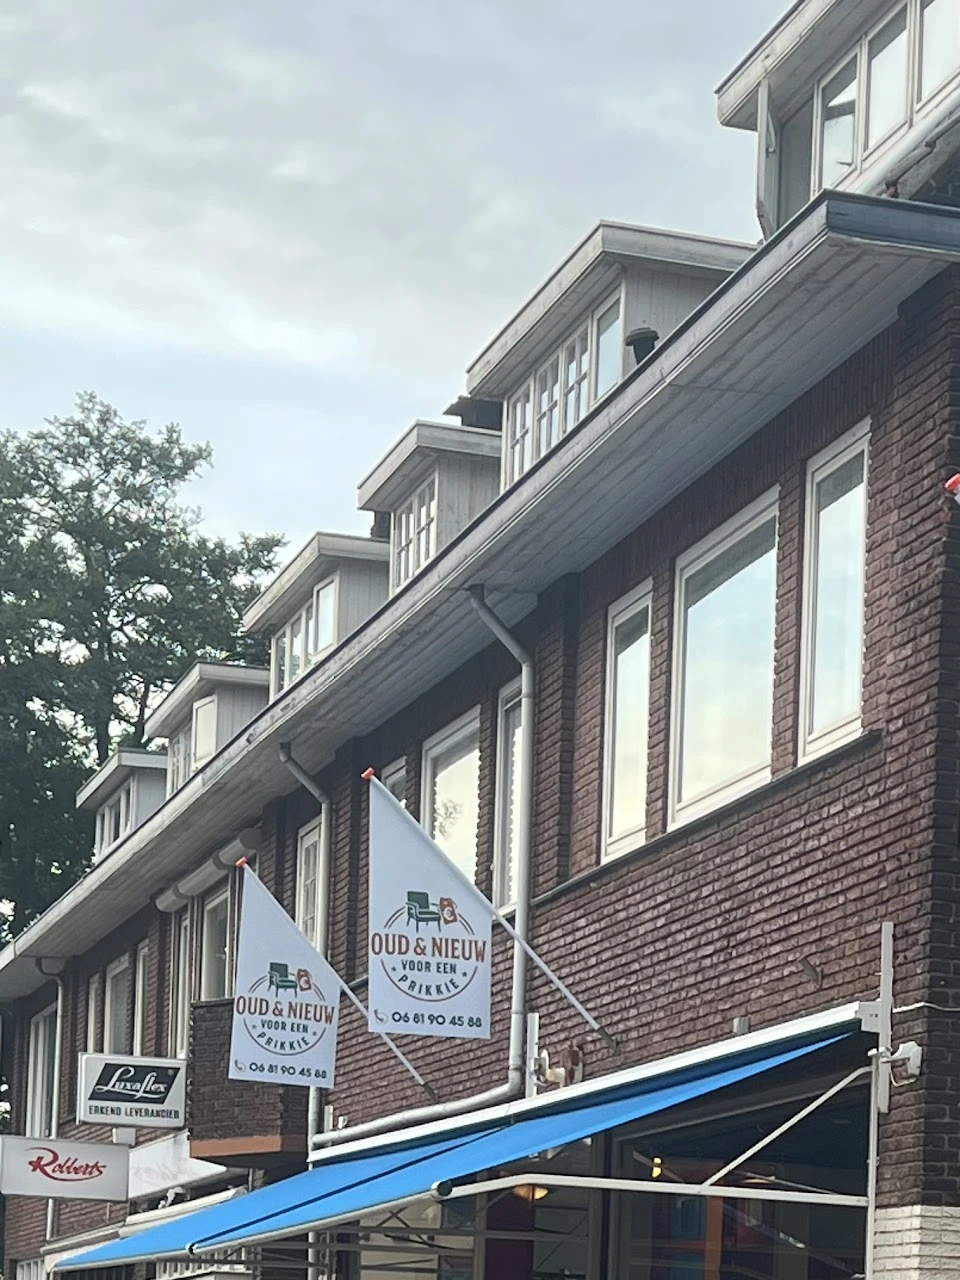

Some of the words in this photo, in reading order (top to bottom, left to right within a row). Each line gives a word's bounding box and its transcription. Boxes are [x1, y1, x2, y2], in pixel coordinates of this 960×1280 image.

[371, 933, 409, 955] OUD
[414, 937, 427, 956] &
[432, 937, 487, 963] NIEUW
[401, 960, 431, 973] VOOR
[436, 962, 457, 974] EEN
[398, 974, 460, 996] PRIKKIE
[236, 996, 268, 1015] OUD
[272, 1001, 283, 1017] &
[287, 1001, 335, 1025] NIEUW
[261, 1019, 286, 1031] VOOR
[291, 1022, 308, 1033] EEN
[392, 1012, 409, 1022] 06
[413, 1013, 425, 1024] 81
[428, 1014, 445, 1025] 90
[449, 1016, 464, 1026] 45
[467, 1017, 482, 1027] 88
[257, 1032, 309, 1051] PRIKKIE
[249, 1062, 265, 1073] 06
[268, 1064, 278, 1074] 81
[281, 1066, 295, 1075] 90
[299, 1067, 311, 1077] 45
[95, 1066, 167, 1099] Luxaflex
[89, 1106, 121, 1115] ERKEND
[125, 1108, 179, 1119] LEVERANCIER
